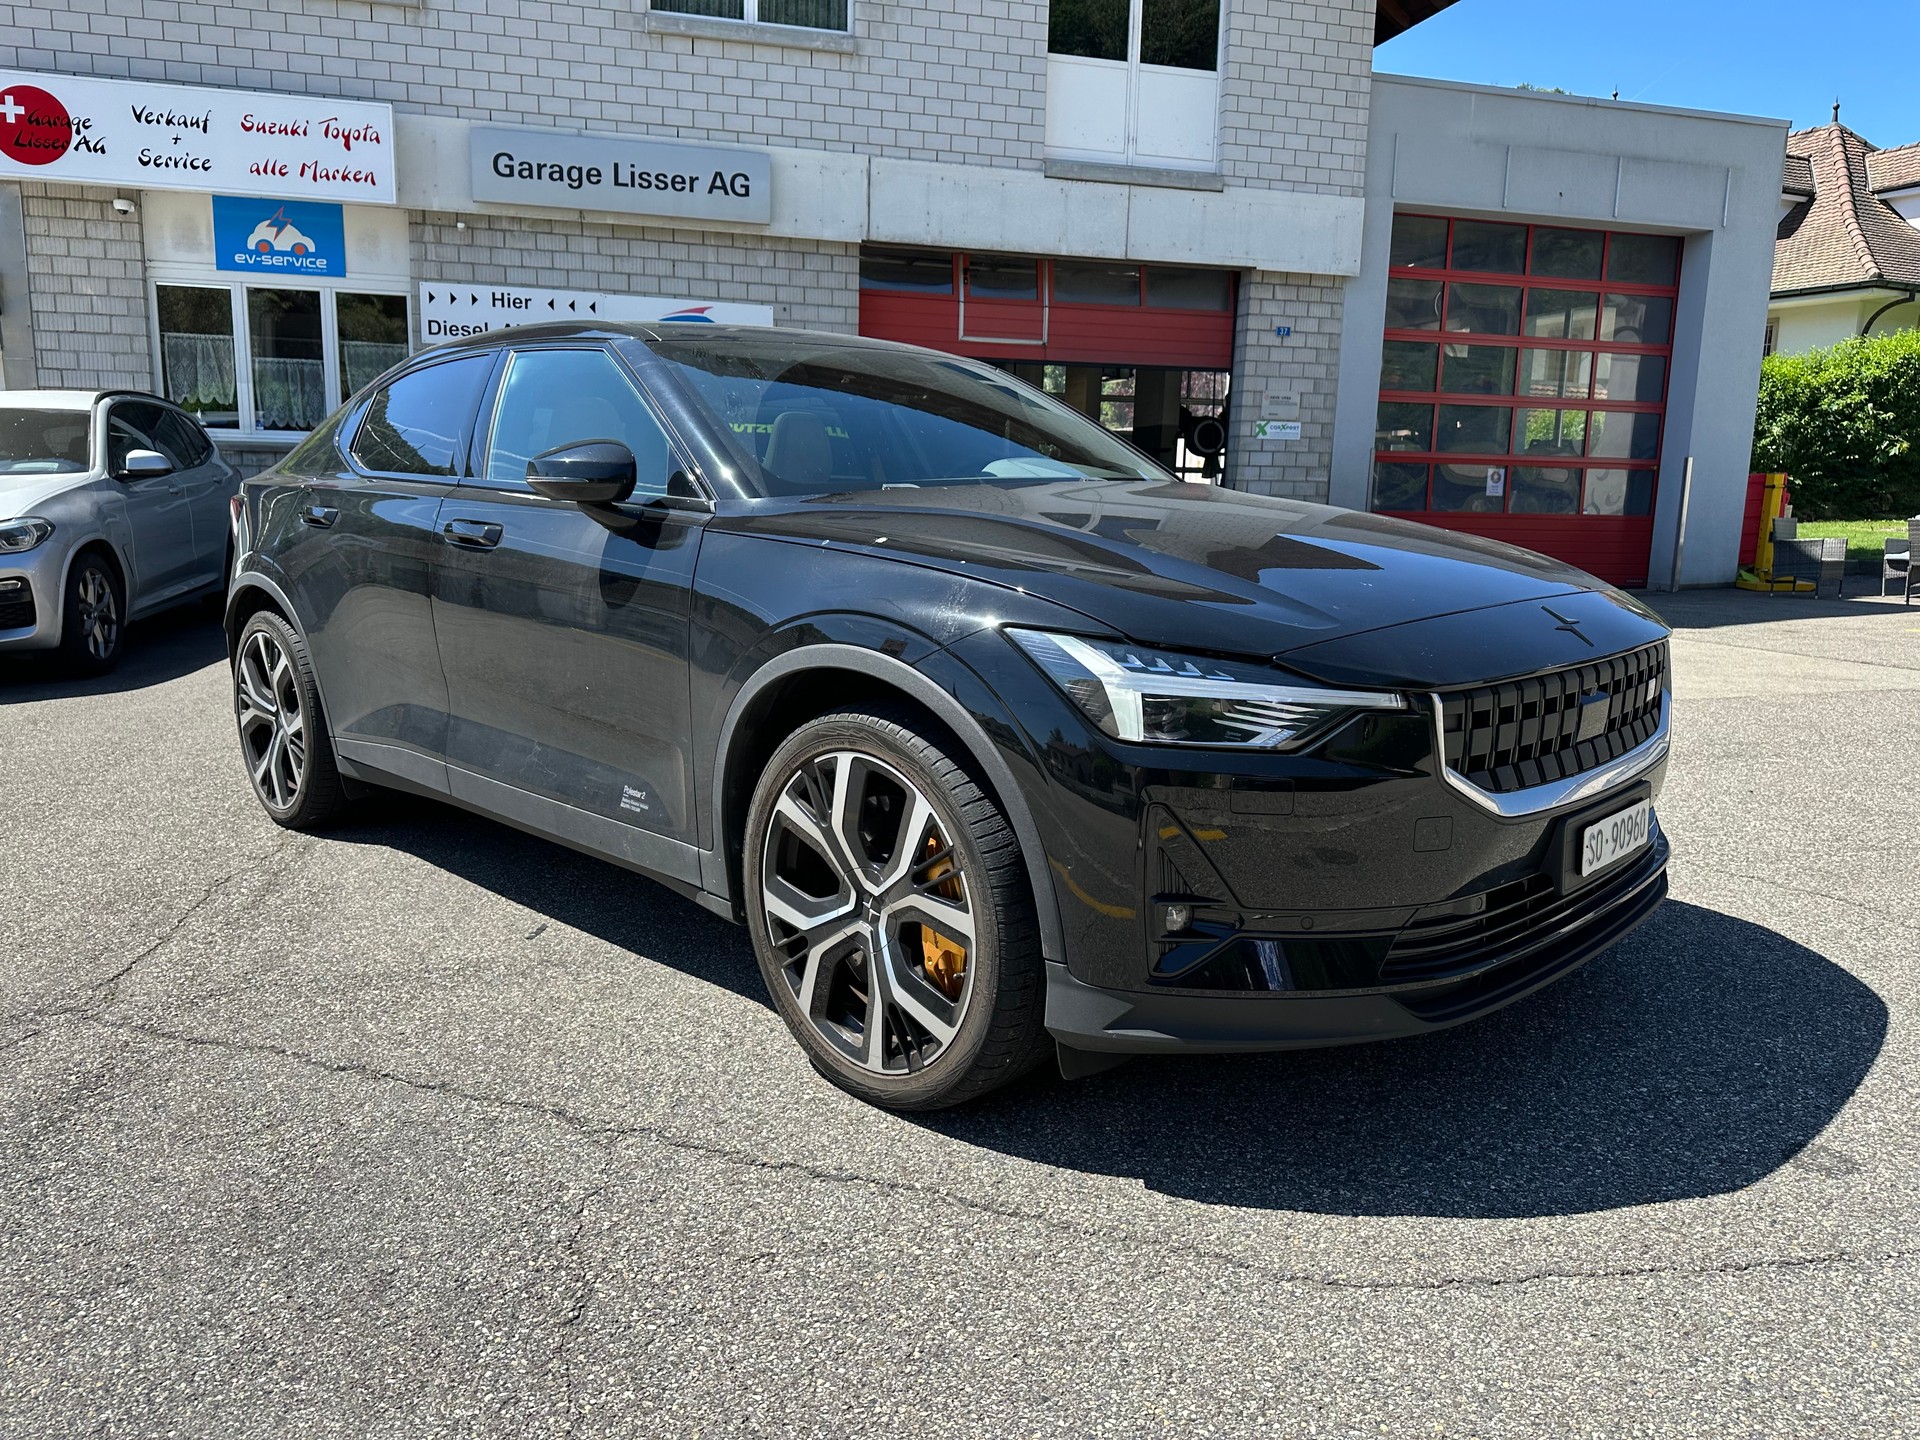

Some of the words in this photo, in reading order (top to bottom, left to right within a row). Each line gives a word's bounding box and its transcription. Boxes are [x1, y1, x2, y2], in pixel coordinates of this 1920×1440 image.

[27, 108, 93, 136] Garage
[131, 104, 212, 134] Verkauf
[13, 130, 71, 151] Lisser
[73, 134, 107, 155] AG
[240, 113, 310, 137] Suzuki
[318, 116, 381, 152] Toyota
[138, 147, 213, 172] Service
[249, 158, 290, 177] alle
[299, 159, 377, 186] Marken
[492, 152, 603, 190] Garage
[613, 162, 700, 194] Lisser
[707, 170, 751, 198] AG
[234, 253, 327, 269] ev-service
[491, 291, 533, 310] Hier
[427, 319, 489, 337] Diesel
